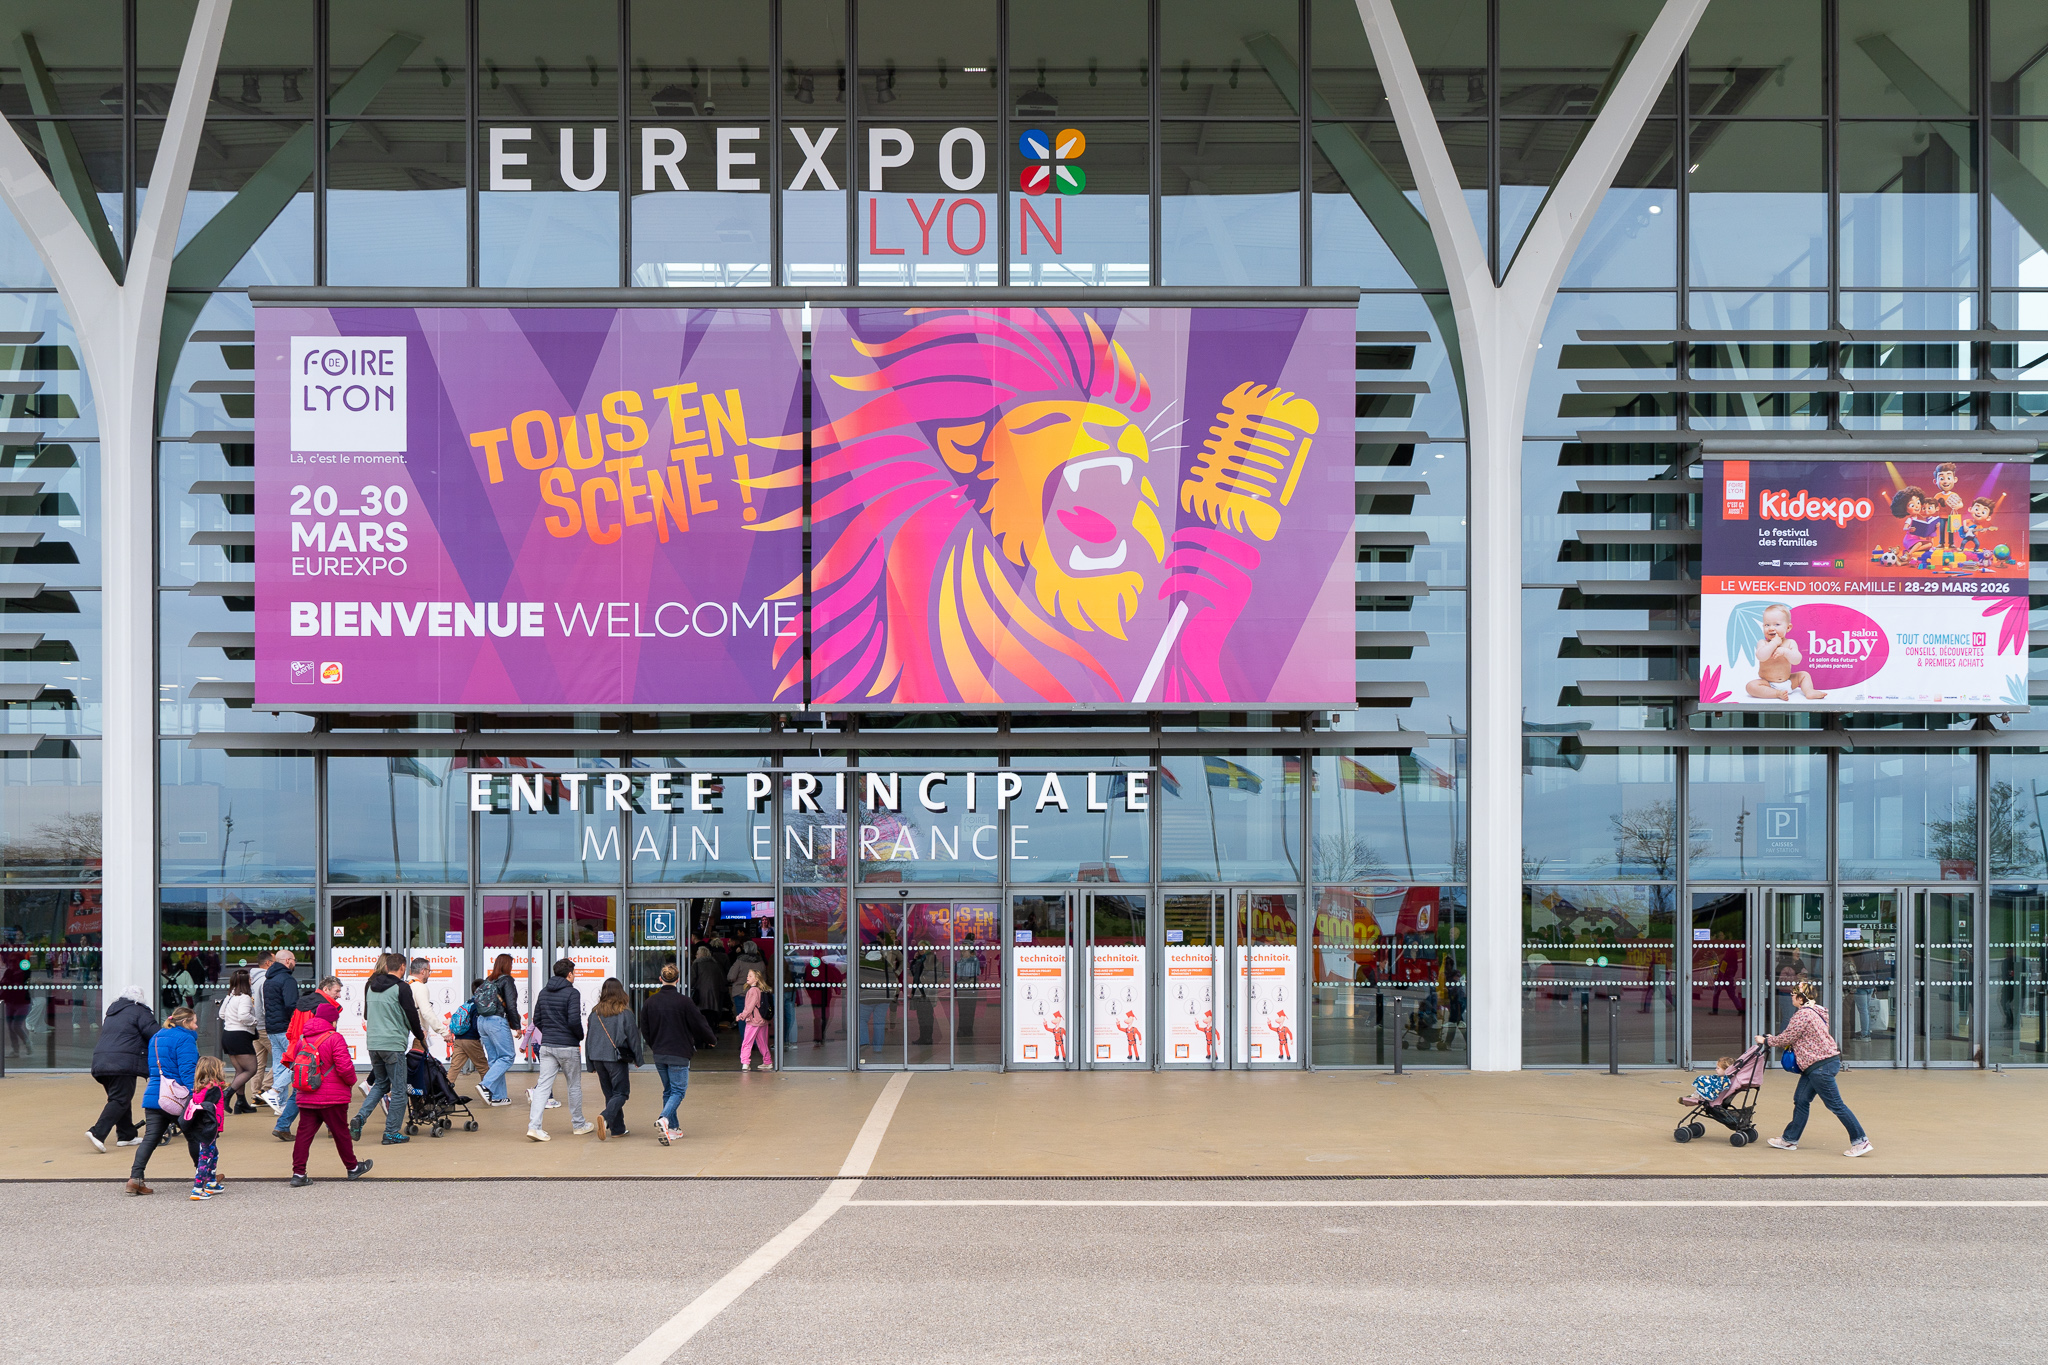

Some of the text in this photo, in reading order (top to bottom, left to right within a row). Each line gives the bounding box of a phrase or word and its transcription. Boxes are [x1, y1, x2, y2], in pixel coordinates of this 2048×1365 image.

[489, 128, 985, 191] EUREXPO
[870, 198, 1062, 255] LYON
[304, 349, 394, 376] FOIRE
[328, 358, 340, 368] DE
[304, 385, 394, 412] LYON
[470, 382, 748, 484] TOUS EN
[290, 454, 408, 464] Là, c'est le moment.
[290, 485, 408, 516] 20_30
[734, 454, 757, 522] !
[1762, 492, 1872, 526] Kidexpo
[292, 522, 408, 552] MARS
[1758, 528, 1809, 537] Le festival
[1758, 538, 1818, 546] des familles
[292, 557, 407, 576] EUREXPO
[1721, 581, 2010, 592] LE WEEK-END 100% FAMILLE 28-29 MARS 2026
[290, 602, 797, 637] BIENVENUE WELCOME
[1852, 628, 1878, 637] salon
[1807, 630, 1878, 661] baby
[1896, 633, 1985, 646] TOUT COMMENCE ICI
[1906, 646, 1984, 656] CONSEILS, DÉCOUVERTES
[1917, 658, 1984, 667] & PREMIERS ACHATS
[470, 772, 1148, 811] ENTREE PRINCIPALE
[1775, 811, 1790, 836] P
[582, 824, 1029, 861] MAIN ENTRANCE
